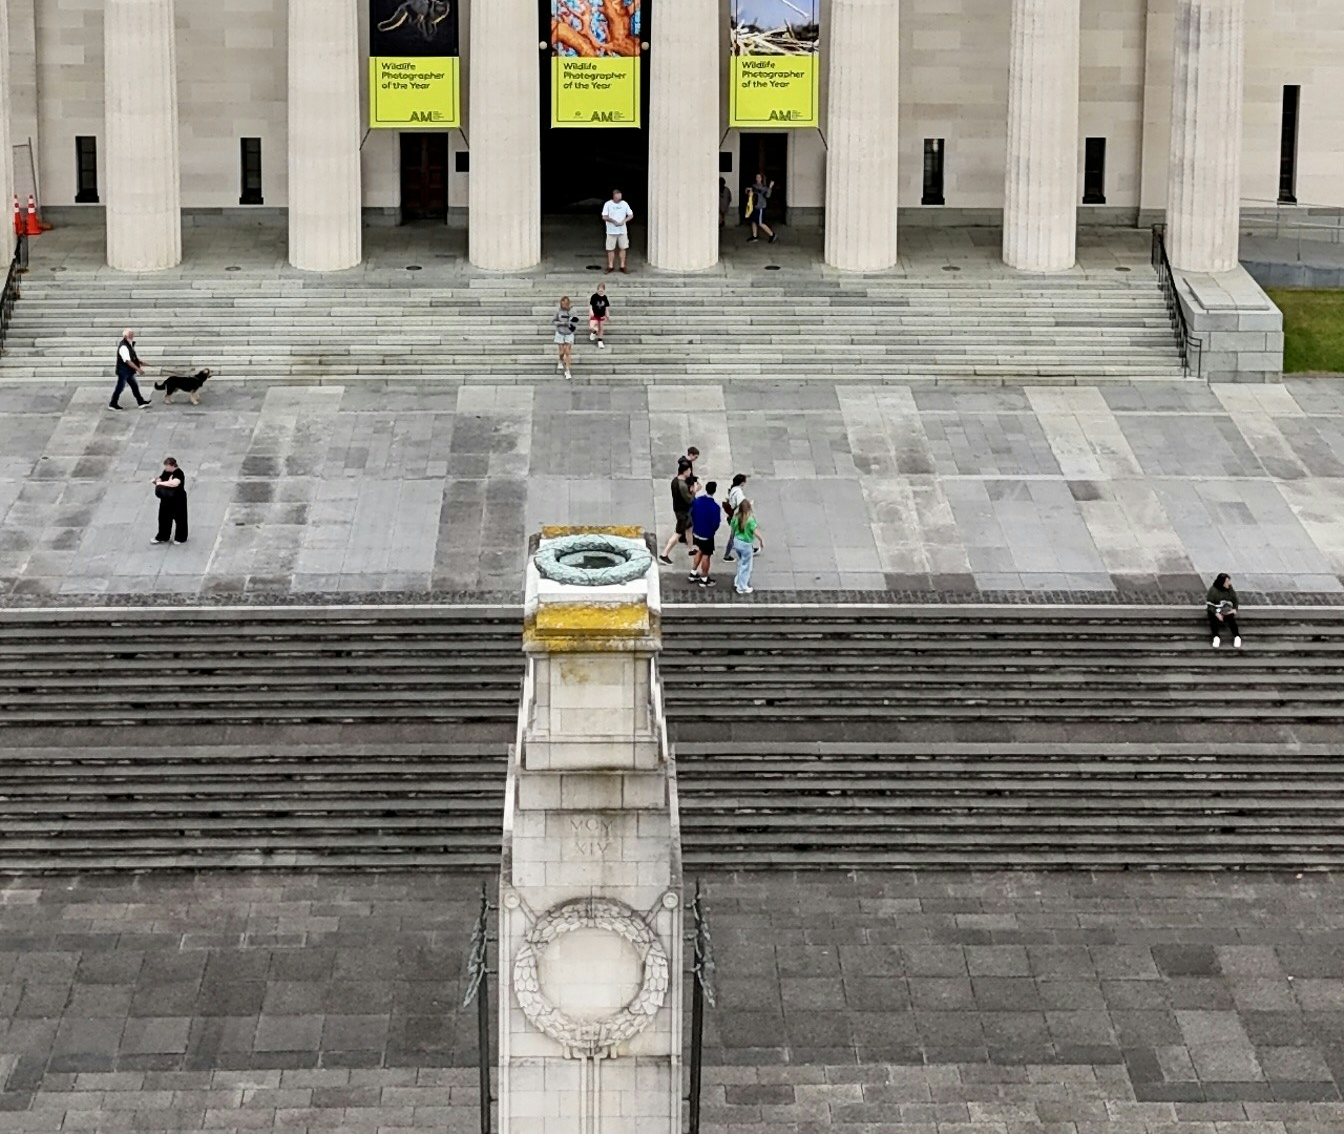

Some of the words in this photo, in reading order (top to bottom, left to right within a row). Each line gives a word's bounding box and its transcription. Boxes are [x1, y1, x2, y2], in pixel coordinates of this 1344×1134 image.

[382, 62, 416, 70] Wildlife
[742, 61, 776, 69] Wildlife
[382, 72, 445, 80] Photographer
[564, 72, 627, 81] Photographer
[742, 70, 805, 79] Photographer
[742, 80, 751, 88] of
[753, 80, 768, 88] the
[769, 80, 790, 88] Year
[410, 111, 432, 122] AM
[591, 111, 614, 122] AM
[769, 110, 792, 121] AM
